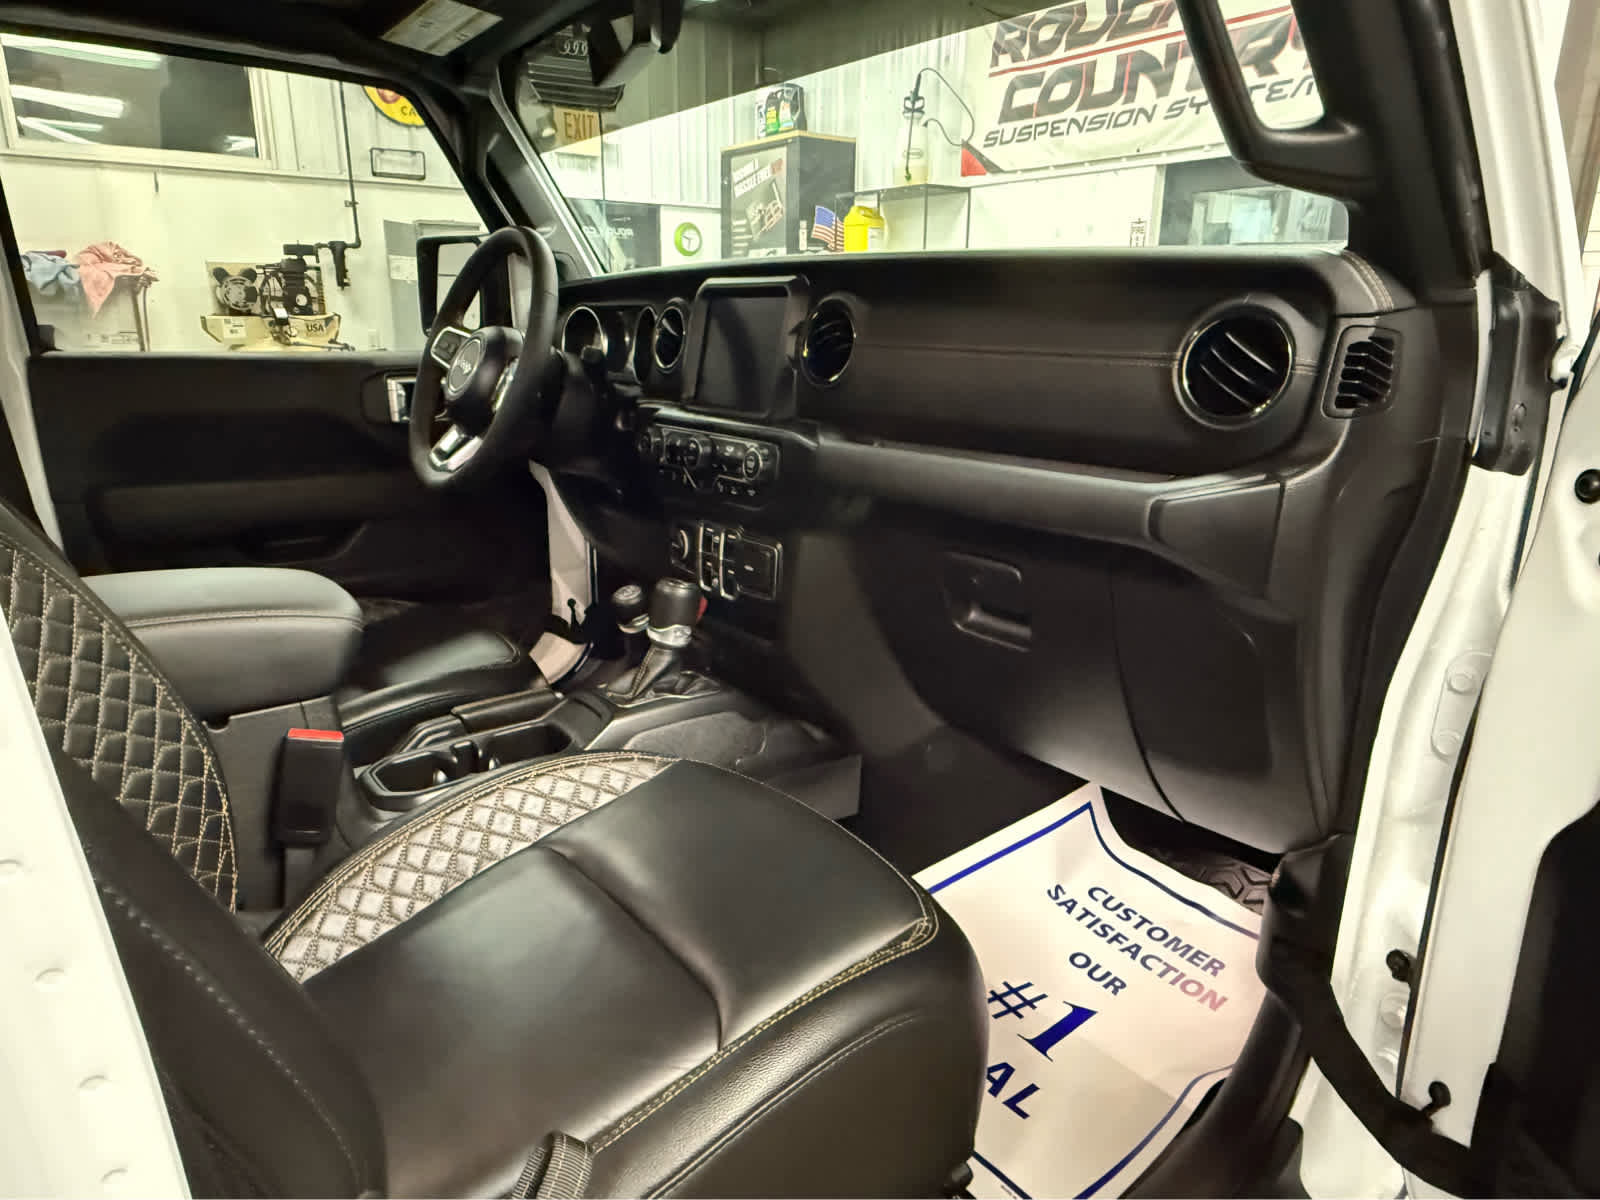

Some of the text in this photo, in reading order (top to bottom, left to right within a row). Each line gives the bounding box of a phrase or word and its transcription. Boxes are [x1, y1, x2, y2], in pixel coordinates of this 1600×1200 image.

[998, 13, 1313, 125] COUNR
[563, 112, 594, 139] EXIT
[983, 104, 1157, 148] SUSPENSION
[305, 322, 324, 332] USA
[1047, 884, 1228, 1011] SATISFACTION
[1087, 886, 1226, 977] CUSTOMER
[1068, 951, 1127, 996] OUR
[986, 980, 1099, 1063] #1
[985, 1061, 1041, 1120] AL
